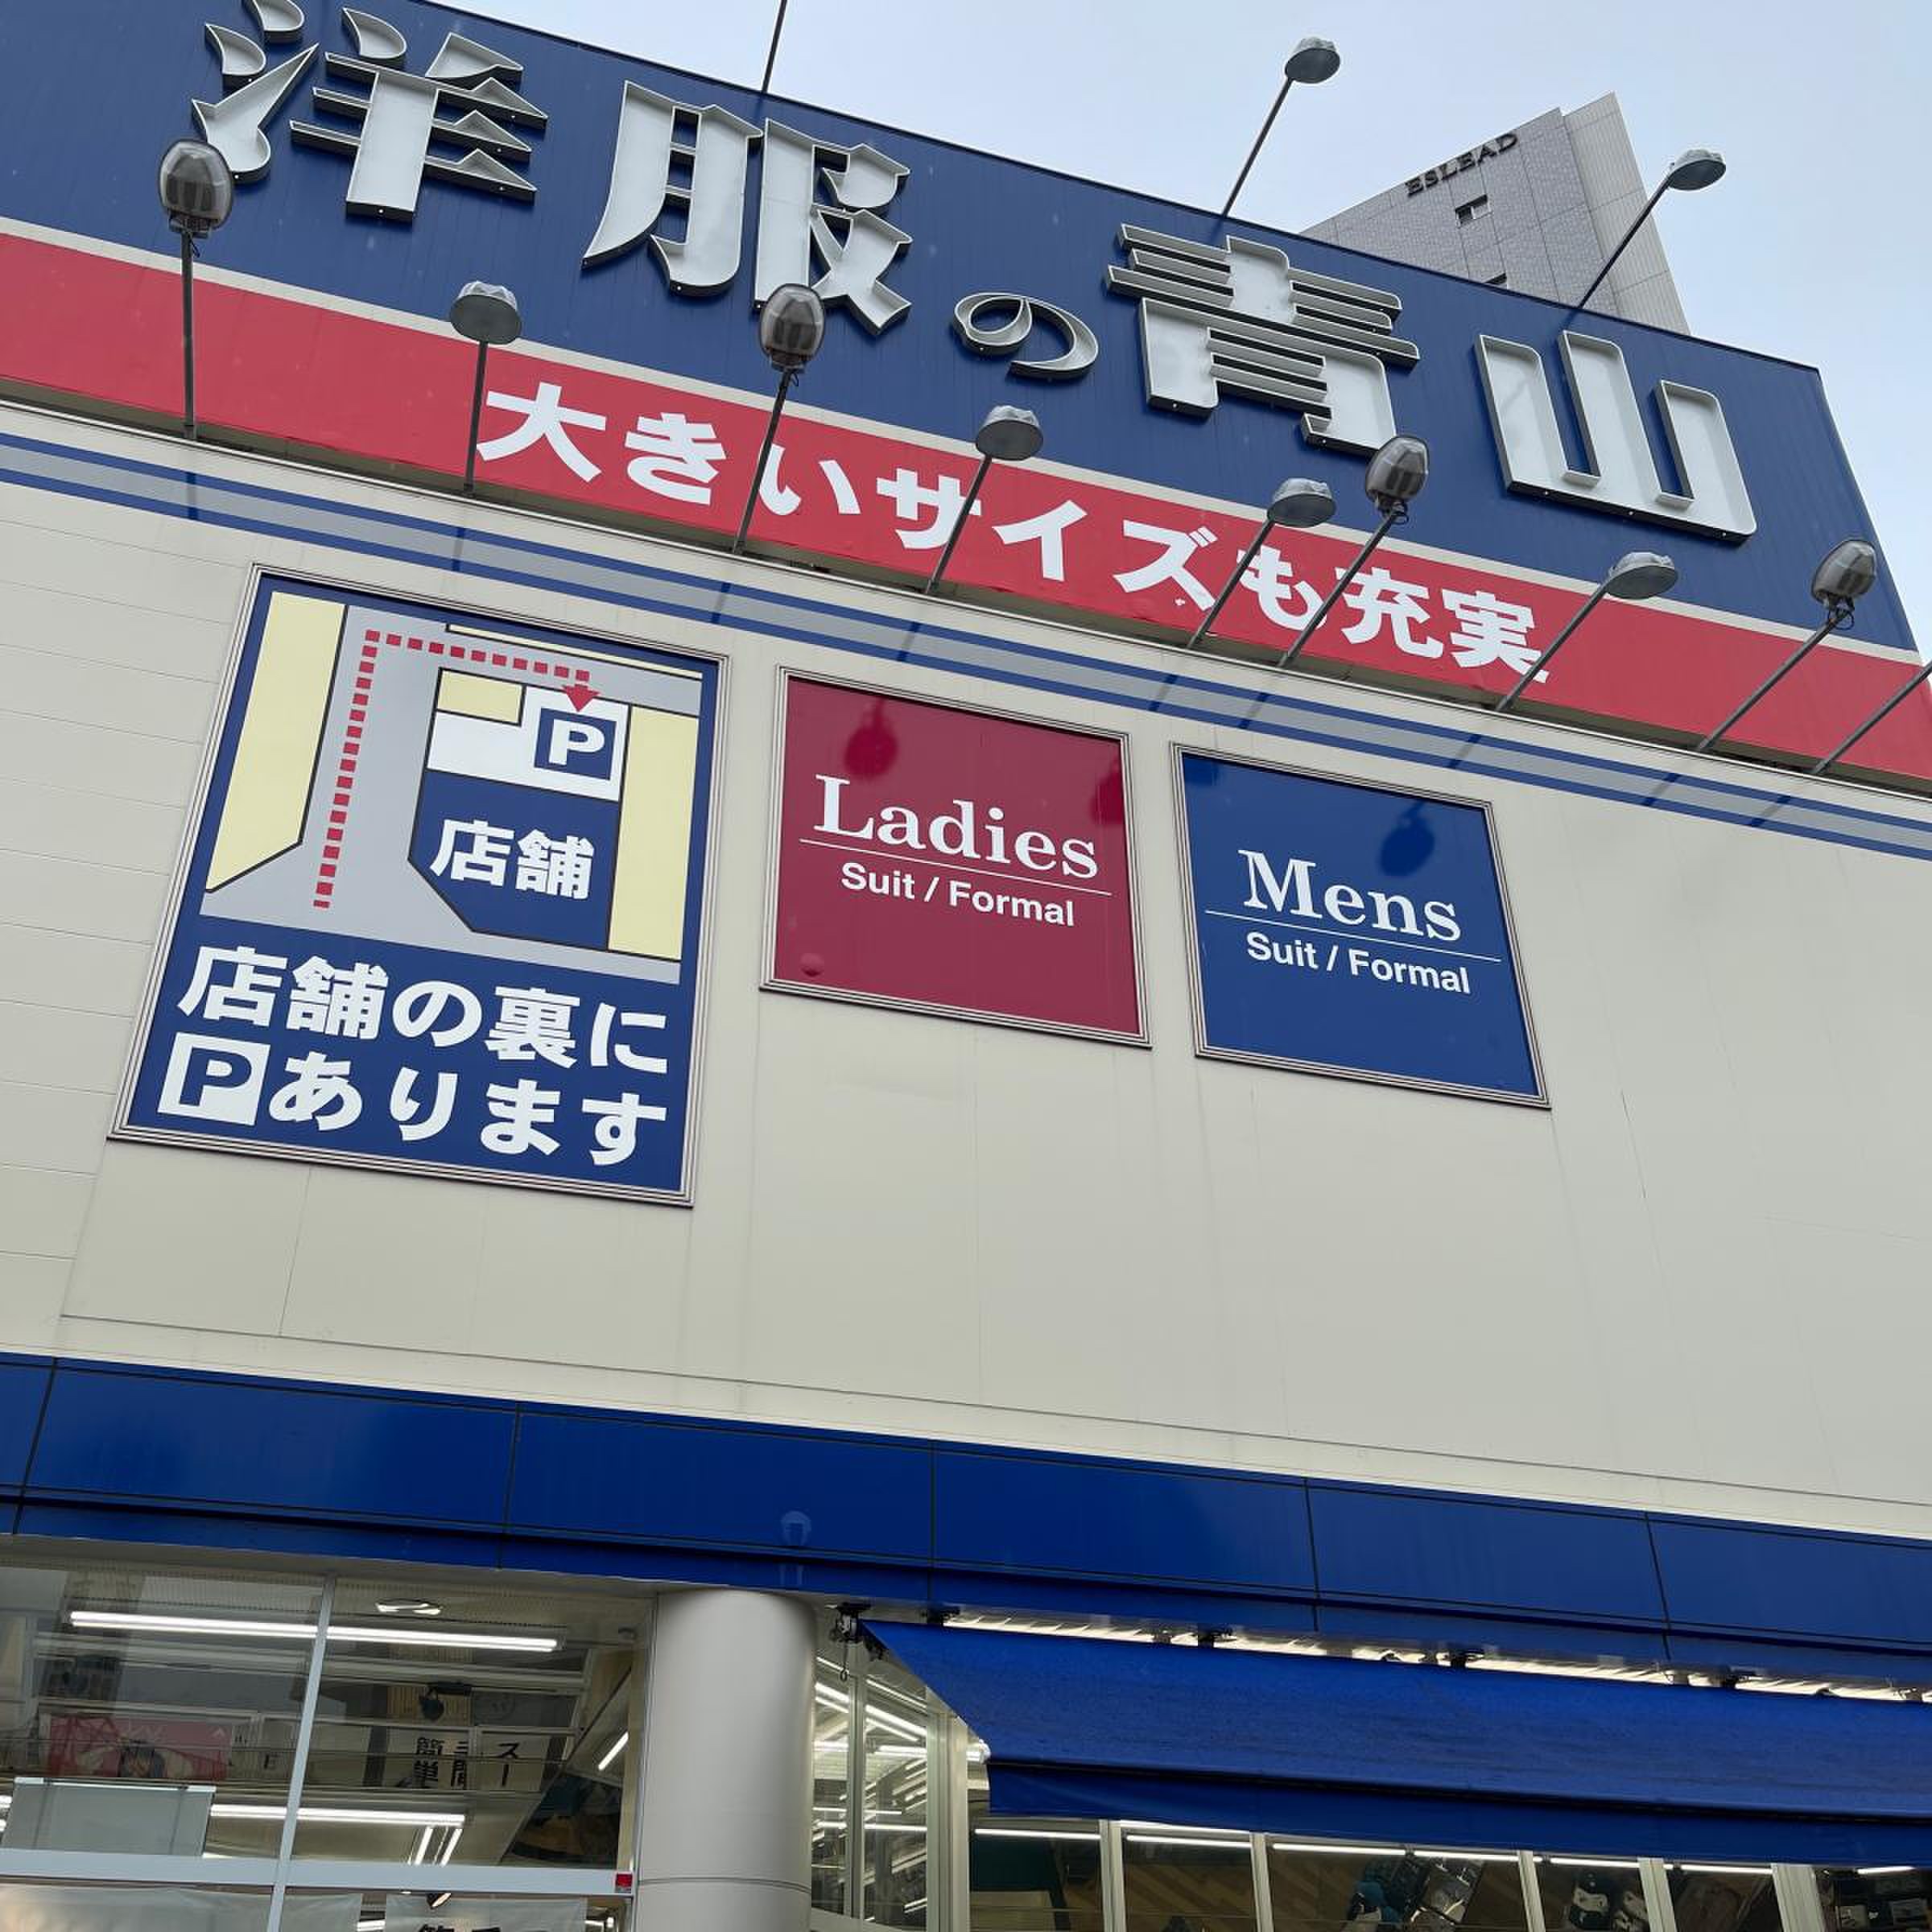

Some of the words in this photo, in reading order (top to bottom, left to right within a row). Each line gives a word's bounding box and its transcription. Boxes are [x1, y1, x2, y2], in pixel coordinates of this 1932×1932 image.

[1405, 133, 1518, 196] ESLEAD
[192, 0, 1757, 543] 洋服の青山
[476, 382, 1550, 683] 大きいサイズも充実
[429, 819, 595, 901] 店舗
[814, 774, 1098, 879] Ladies
[841, 862, 915, 901] Suit
[949, 879, 1075, 927] Formal
[1238, 849, 1462, 942] Mens
[1245, 931, 1319, 970] Suit
[1348, 948, 1472, 995] Formal
[178, 946, 669, 1075] 店舗の裏に
